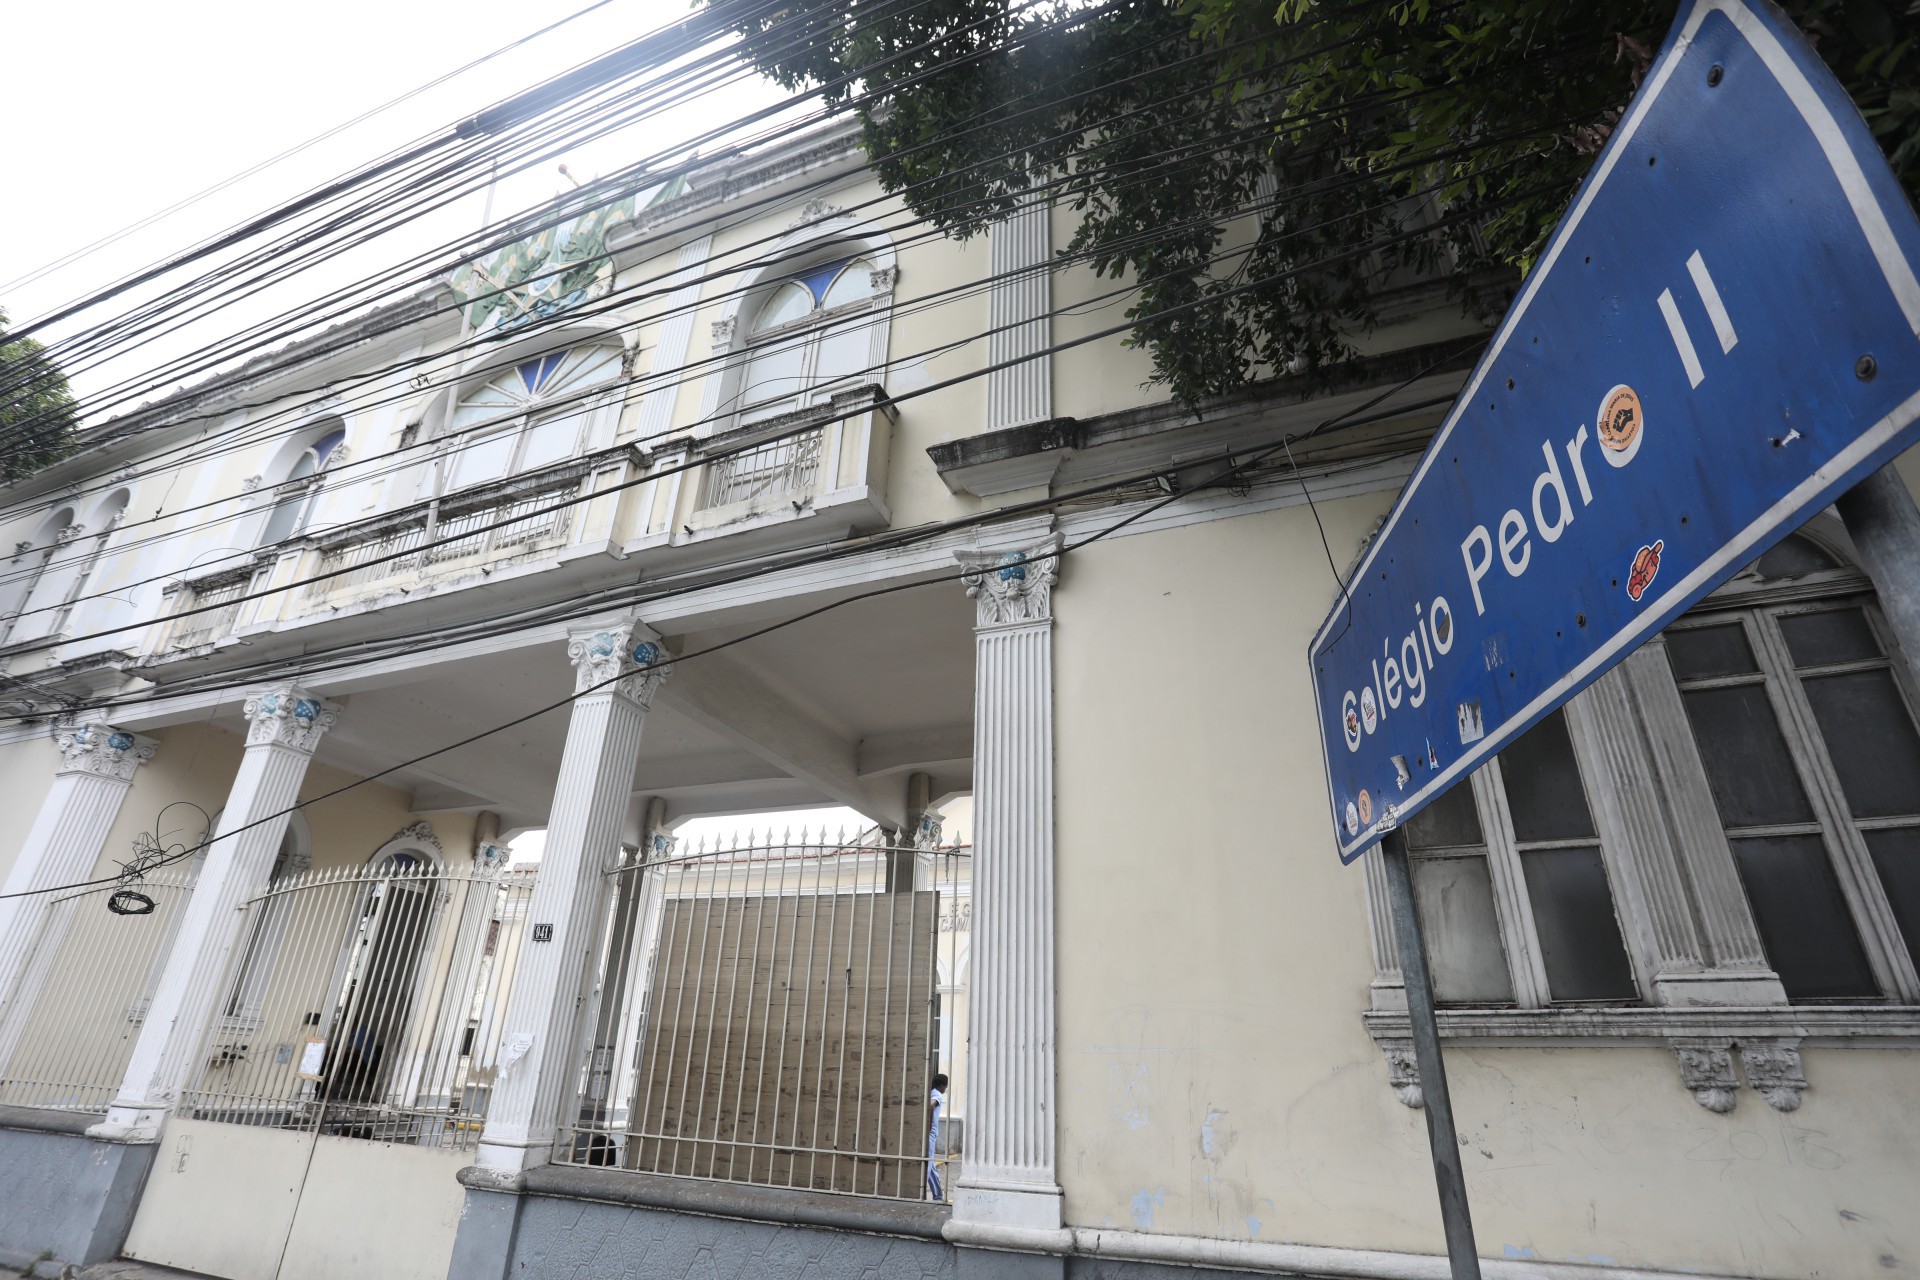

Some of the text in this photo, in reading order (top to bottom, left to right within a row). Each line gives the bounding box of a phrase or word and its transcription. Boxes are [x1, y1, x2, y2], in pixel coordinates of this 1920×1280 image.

[1342, 595, 1455, 753] Colégio
[1460, 384, 1644, 616] Pedro
[536, 926, 548, 938] 941
